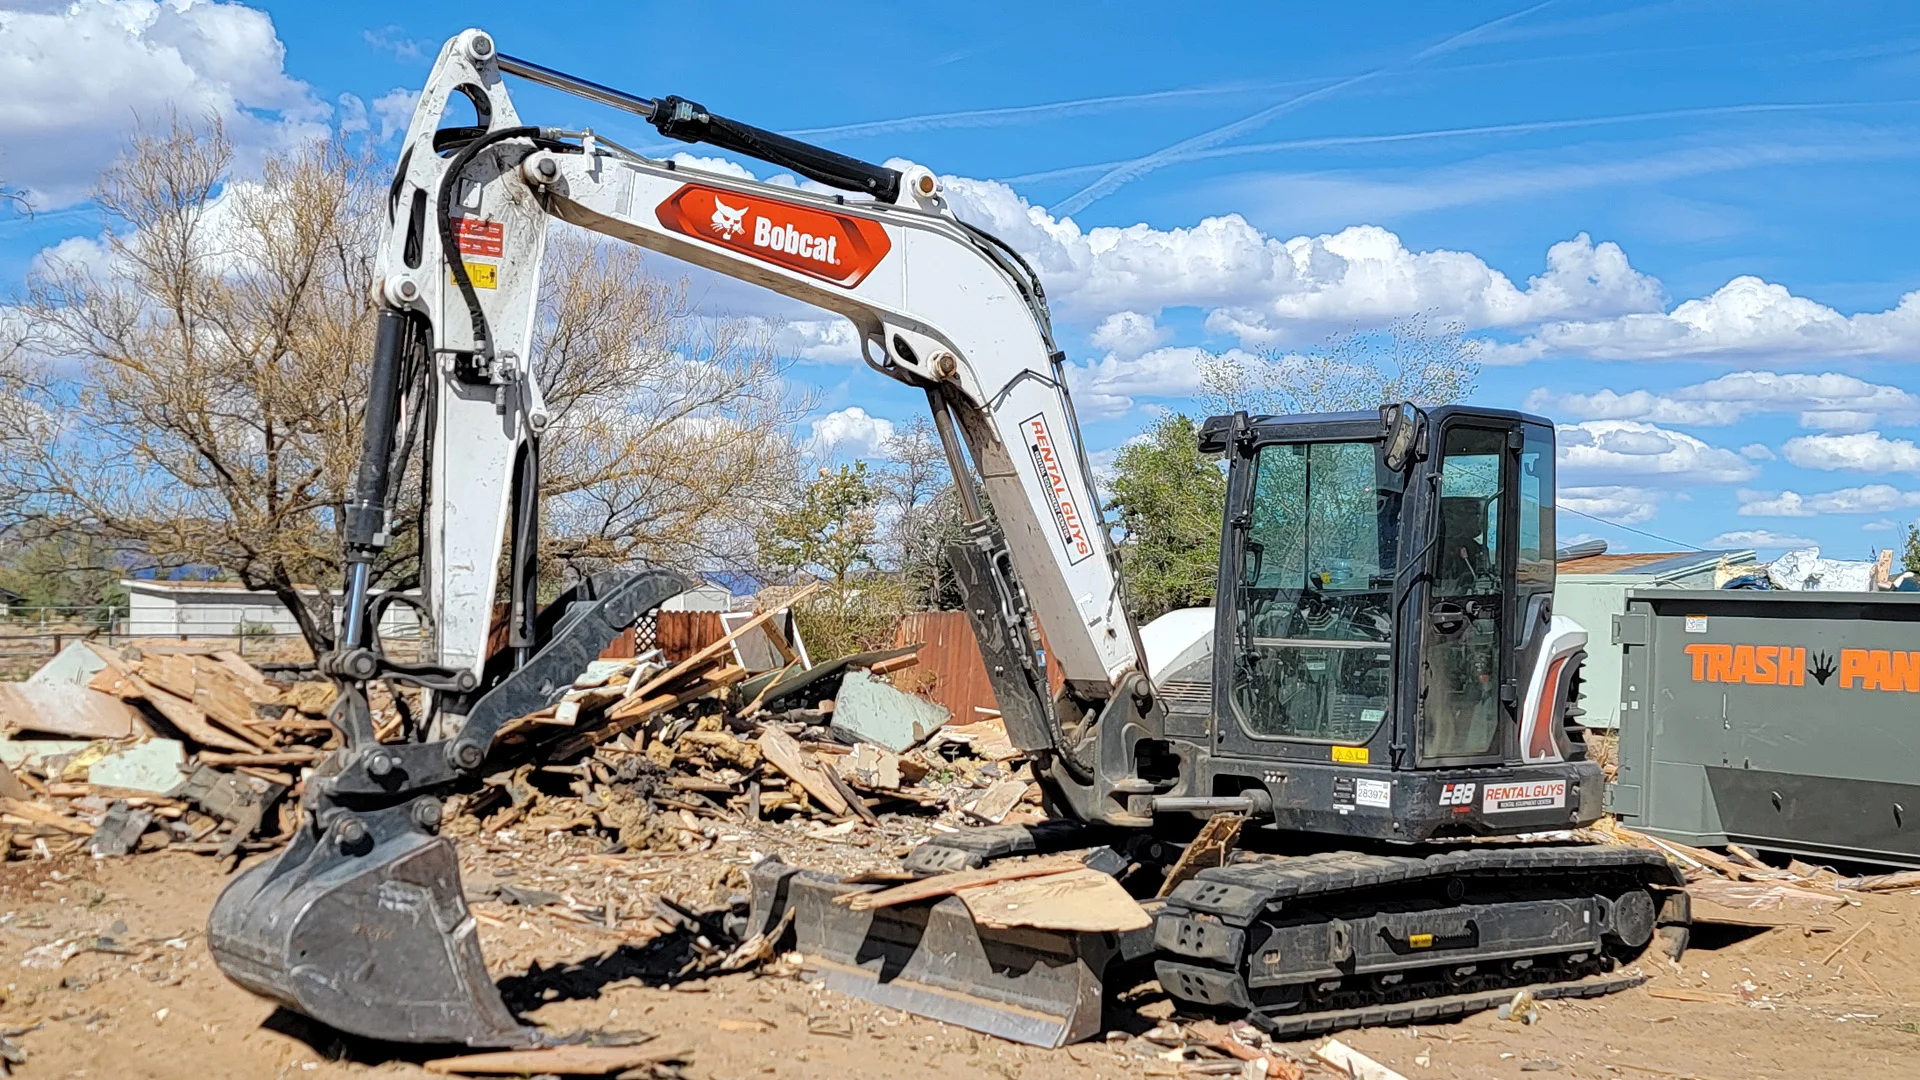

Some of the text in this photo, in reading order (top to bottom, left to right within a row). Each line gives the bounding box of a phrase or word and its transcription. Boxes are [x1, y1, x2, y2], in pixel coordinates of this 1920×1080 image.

[754, 216, 837, 264] Bobcat
[1034, 450, 1046, 476] RENTAL
[1031, 421, 1089, 555] RENTAL GUYS
[1684, 643, 1920, 692] TRASH PAN
[1358, 788, 1388, 801] 283974
[1439, 783, 1476, 805] E88
[1485, 783, 1564, 801] RENTAL GUYS
